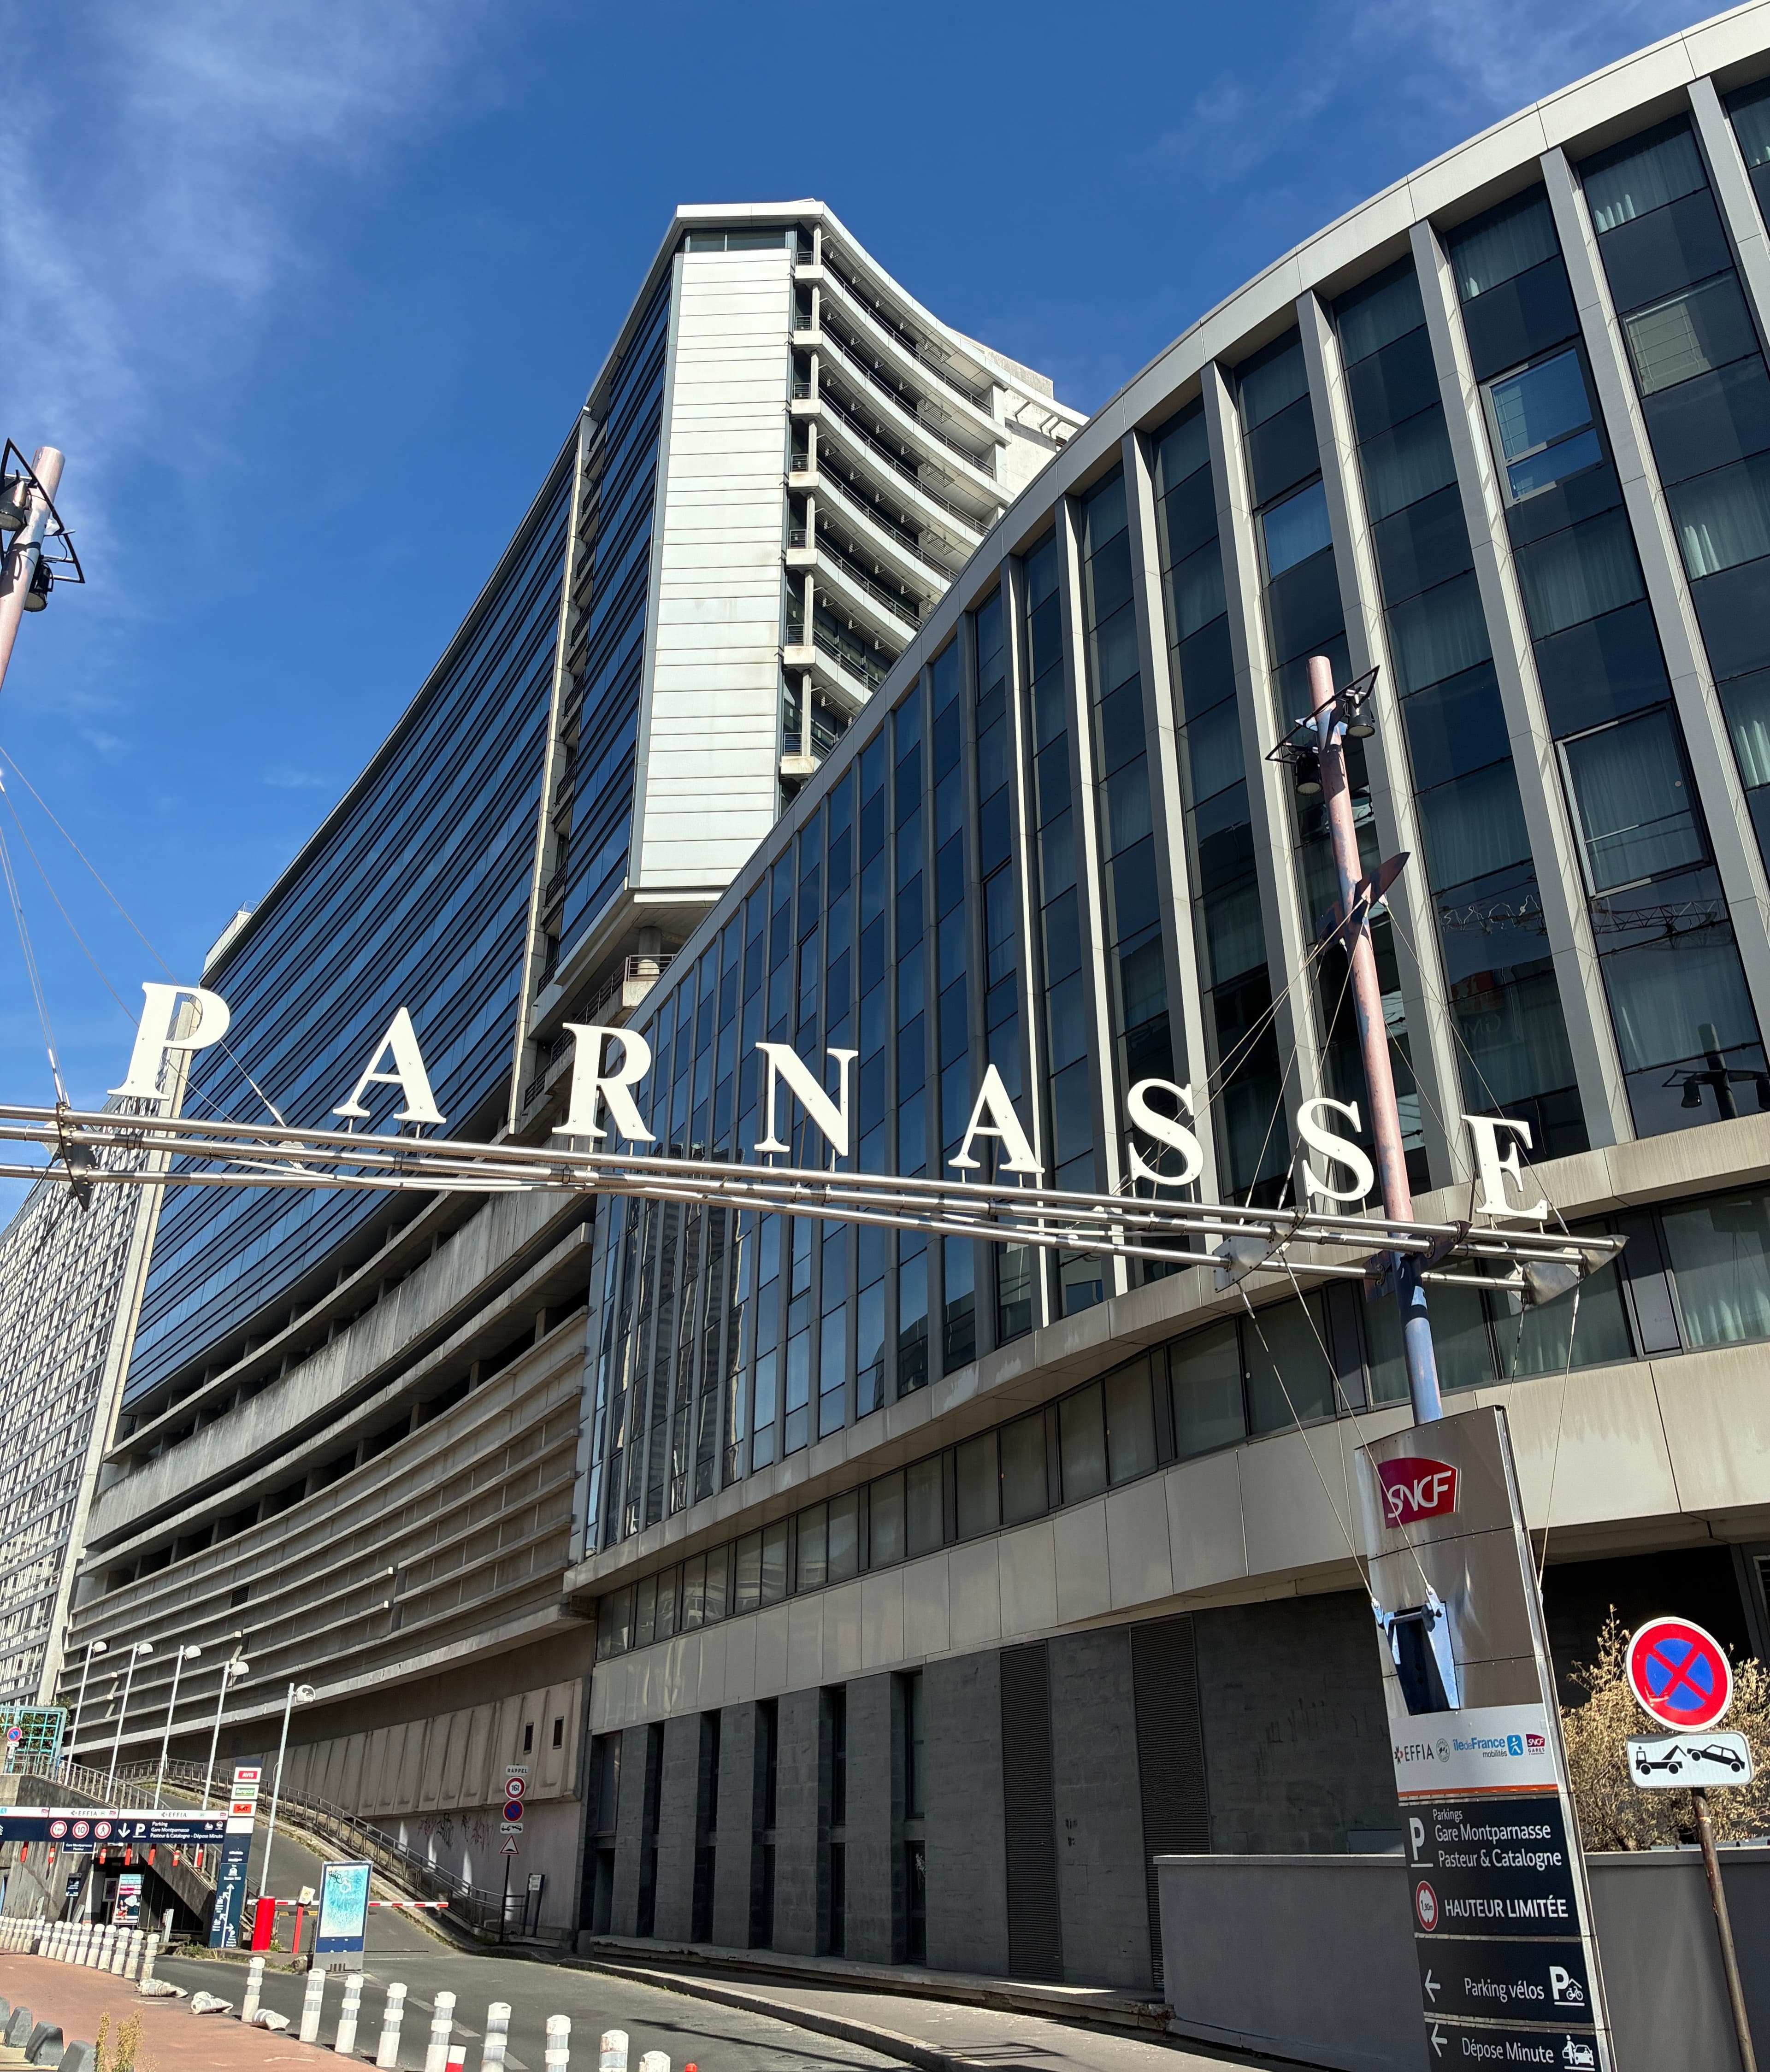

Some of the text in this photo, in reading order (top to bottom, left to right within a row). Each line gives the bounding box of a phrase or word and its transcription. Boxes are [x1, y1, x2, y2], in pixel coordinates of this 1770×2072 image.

[107, 982, 1546, 1221] PARNASSE
[1388, 1470, 1451, 1518] SNCF
[1404, 1744, 1434, 1761] EFFIA
[1482, 1749, 1507, 1758] mobilités
[1433, 1808, 1463, 1823] Parkings
[136, 1823, 146, 1836] P
[1409, 1817, 1425, 1860] P
[1435, 1823, 1551, 1845] Gare Montparnasse
[1438, 1848, 1562, 1871] Pasteur & Catalogne
[1444, 1895, 1569, 1918] HAUTEUR LIMITÉE
[1464, 1978, 1545, 2003] Parking vélos
[1462, 2037, 1554, 2063] Dépose Minute
